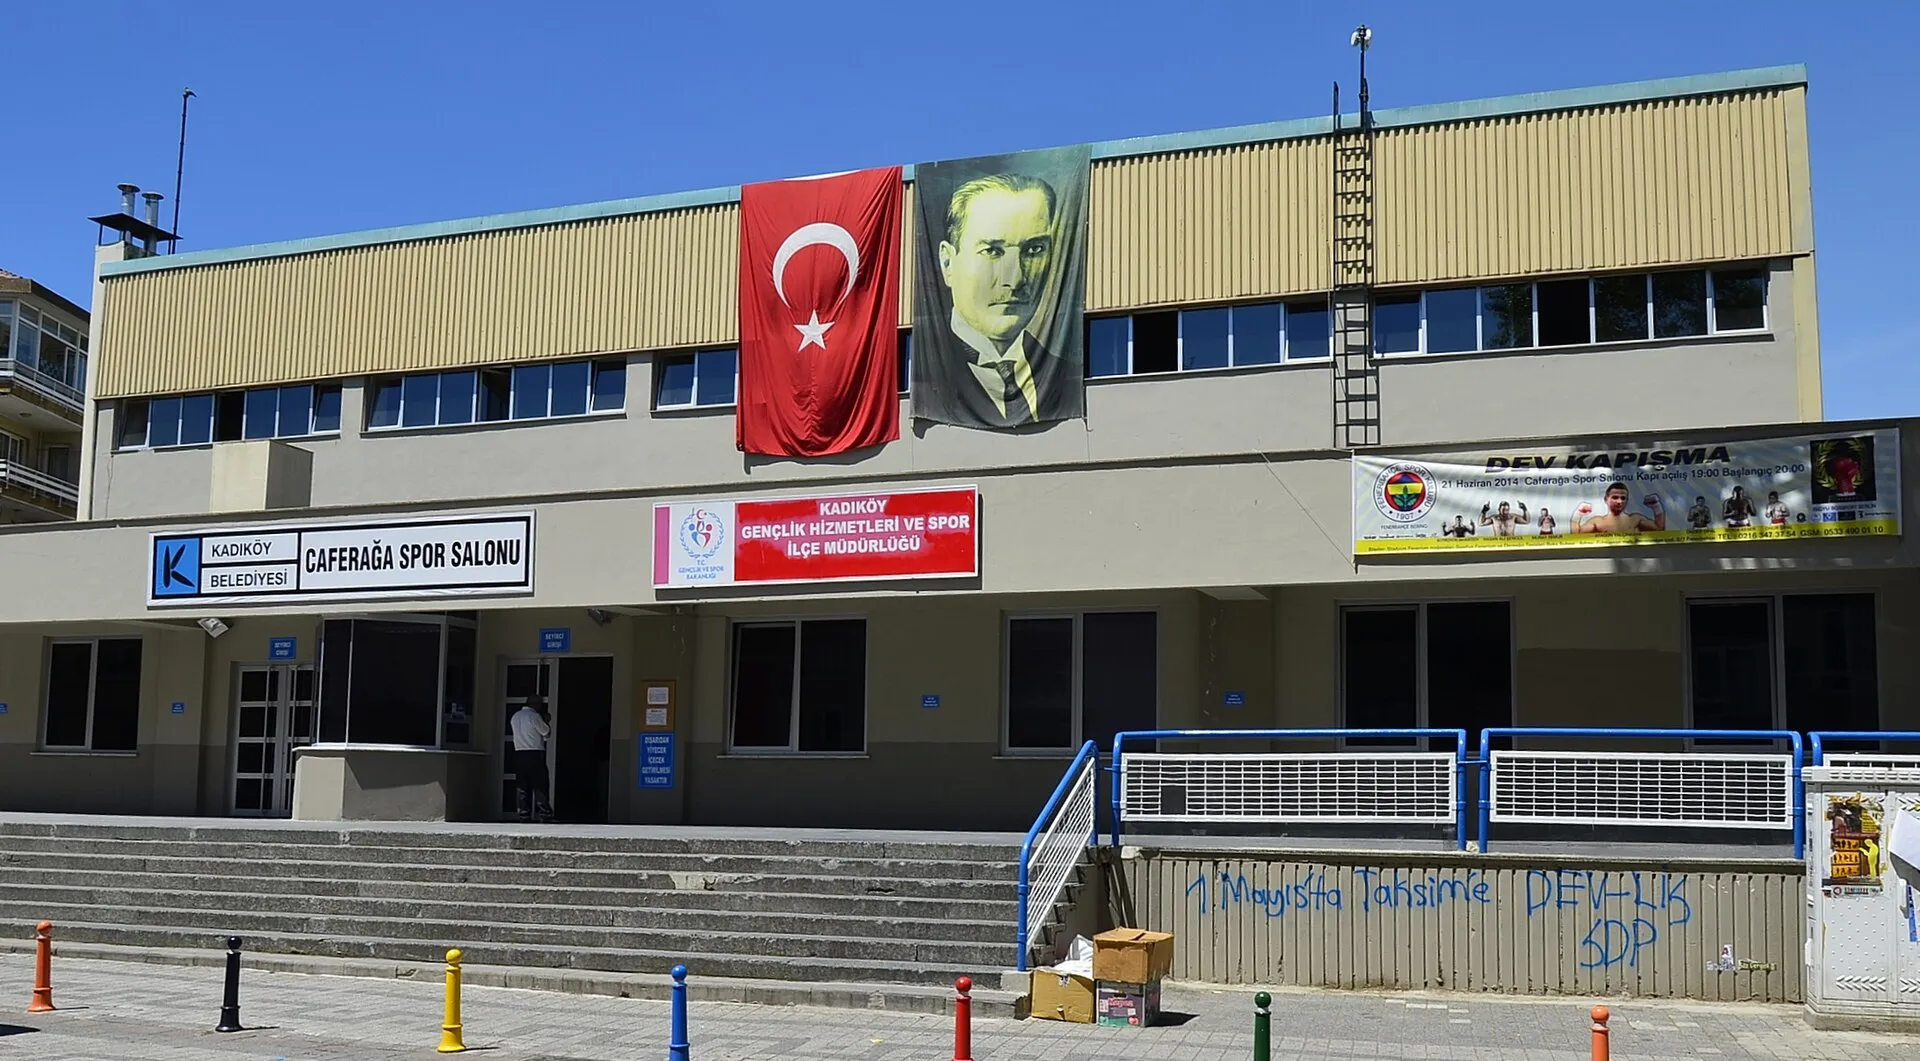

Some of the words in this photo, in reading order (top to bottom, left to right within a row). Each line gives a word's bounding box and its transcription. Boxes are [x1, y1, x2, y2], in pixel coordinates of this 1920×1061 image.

[1485, 455, 1558, 474] DEV
[1565, 446, 1731, 471] KAPIŞMA
[1441, 480, 1452, 489] 21
[1456, 479, 1492, 488] Haziran
[1494, 478, 1519, 487] 2014
[1524, 476, 1570, 486] Caferağa
[1572, 474, 1597, 485] Spor
[1599, 471, 1633, 482] Salonu
[1636, 469, 1660, 482] Kapı
[1662, 468, 1688, 480] açılış
[1691, 468, 1719, 478] 19:00
[1722, 466, 1772, 478] Başlangıç
[1775, 464, 1805, 474] 20:00
[820, 499, 888, 516] KADIKÖY
[741, 521, 806, 541] GENÇLİK
[809, 518, 900, 536] HİZMETLERİ
[904, 517, 925, 531] VE
[928, 514, 970, 530] SPOR
[1874, 525, 1884, 533] 10
[211, 539, 273, 558] KADIKÖY
[305, 539, 394, 574] CAFERAĞA
[399, 542, 445, 569] SPOR
[450, 538, 521, 568] SALONU
[787, 540, 820, 558] İLÇE
[824, 534, 921, 556] MÜDÜRLÜĞÜ
[210, 571, 288, 588] BELEDİYESİ
[1186, 873, 1206, 914] 1
[1580, 918, 1657, 968] SDP
